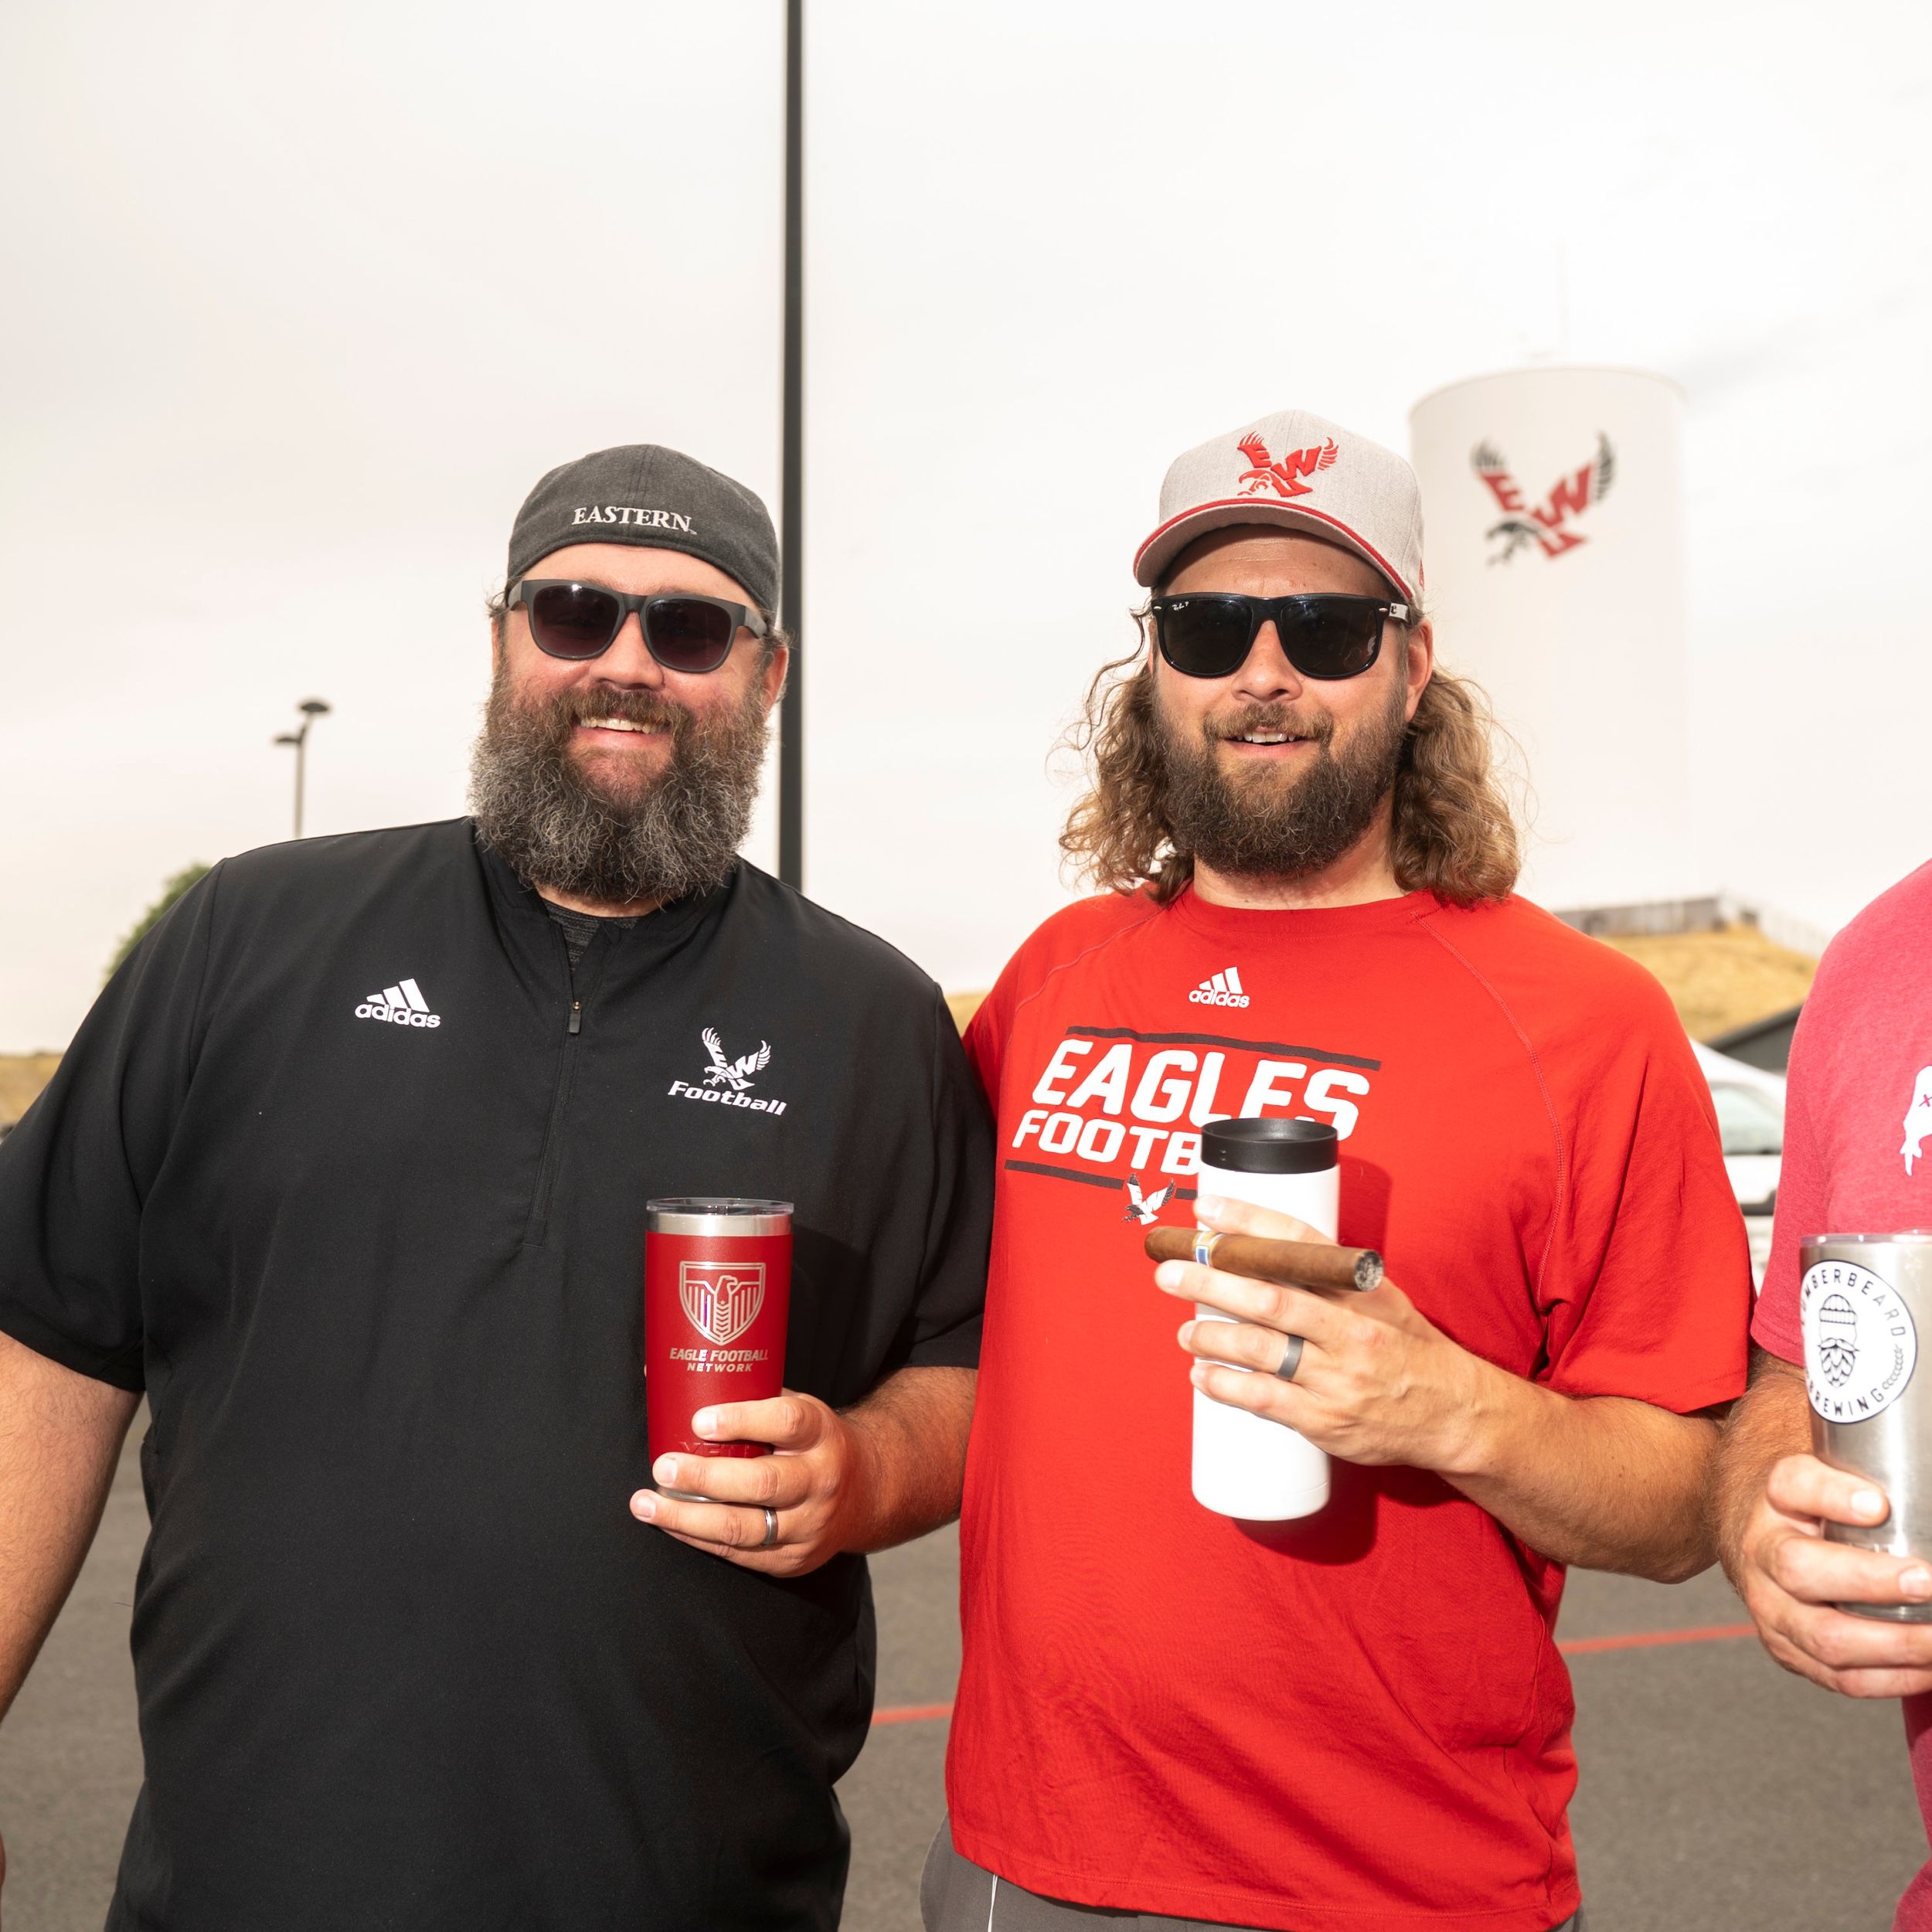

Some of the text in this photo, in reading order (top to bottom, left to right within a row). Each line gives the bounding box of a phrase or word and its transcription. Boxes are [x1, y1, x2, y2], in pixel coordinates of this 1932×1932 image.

[571, 505, 692, 532] EASTERN
[1189, 988, 1250, 1008] adidas
[355, 1003, 441, 1029] adidas
[668, 1080, 787, 1115] Football
[1032, 1039, 1370, 1141] EAGLES
[1012, 1110, 1202, 1175] FOOTB
[669, 1348, 769, 1362] EAGLE FOOTBALL
[687, 1362, 753, 1372] NETWORK
